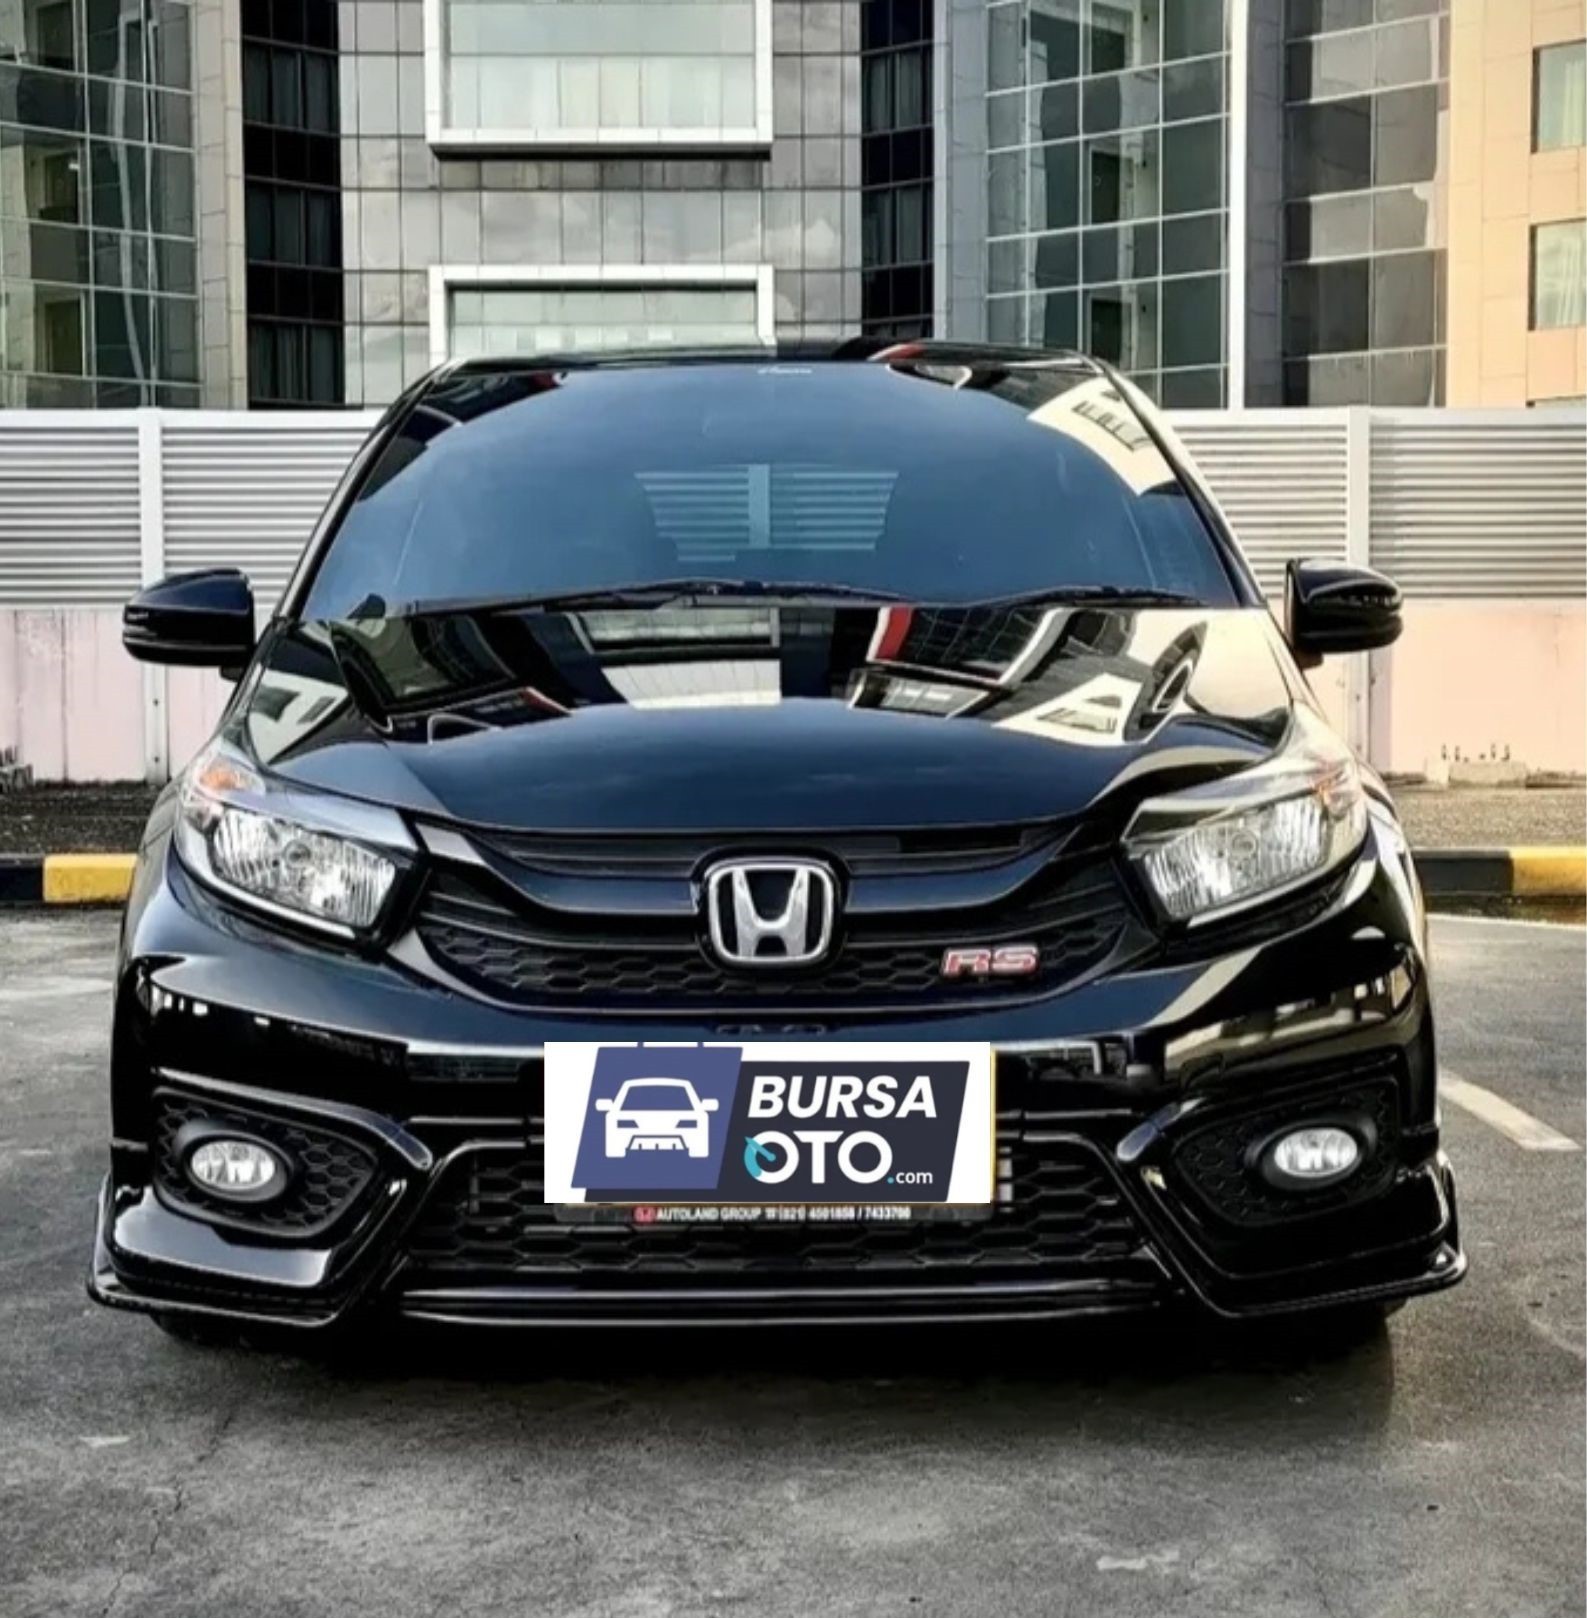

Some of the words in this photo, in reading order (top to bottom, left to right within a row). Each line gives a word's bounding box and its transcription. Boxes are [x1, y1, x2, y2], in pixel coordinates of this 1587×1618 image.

[942, 945, 1038, 977] RS
[656, 1206, 719, 1221] AUTOLAND
[720, 1206, 761, 1221] GROUP
